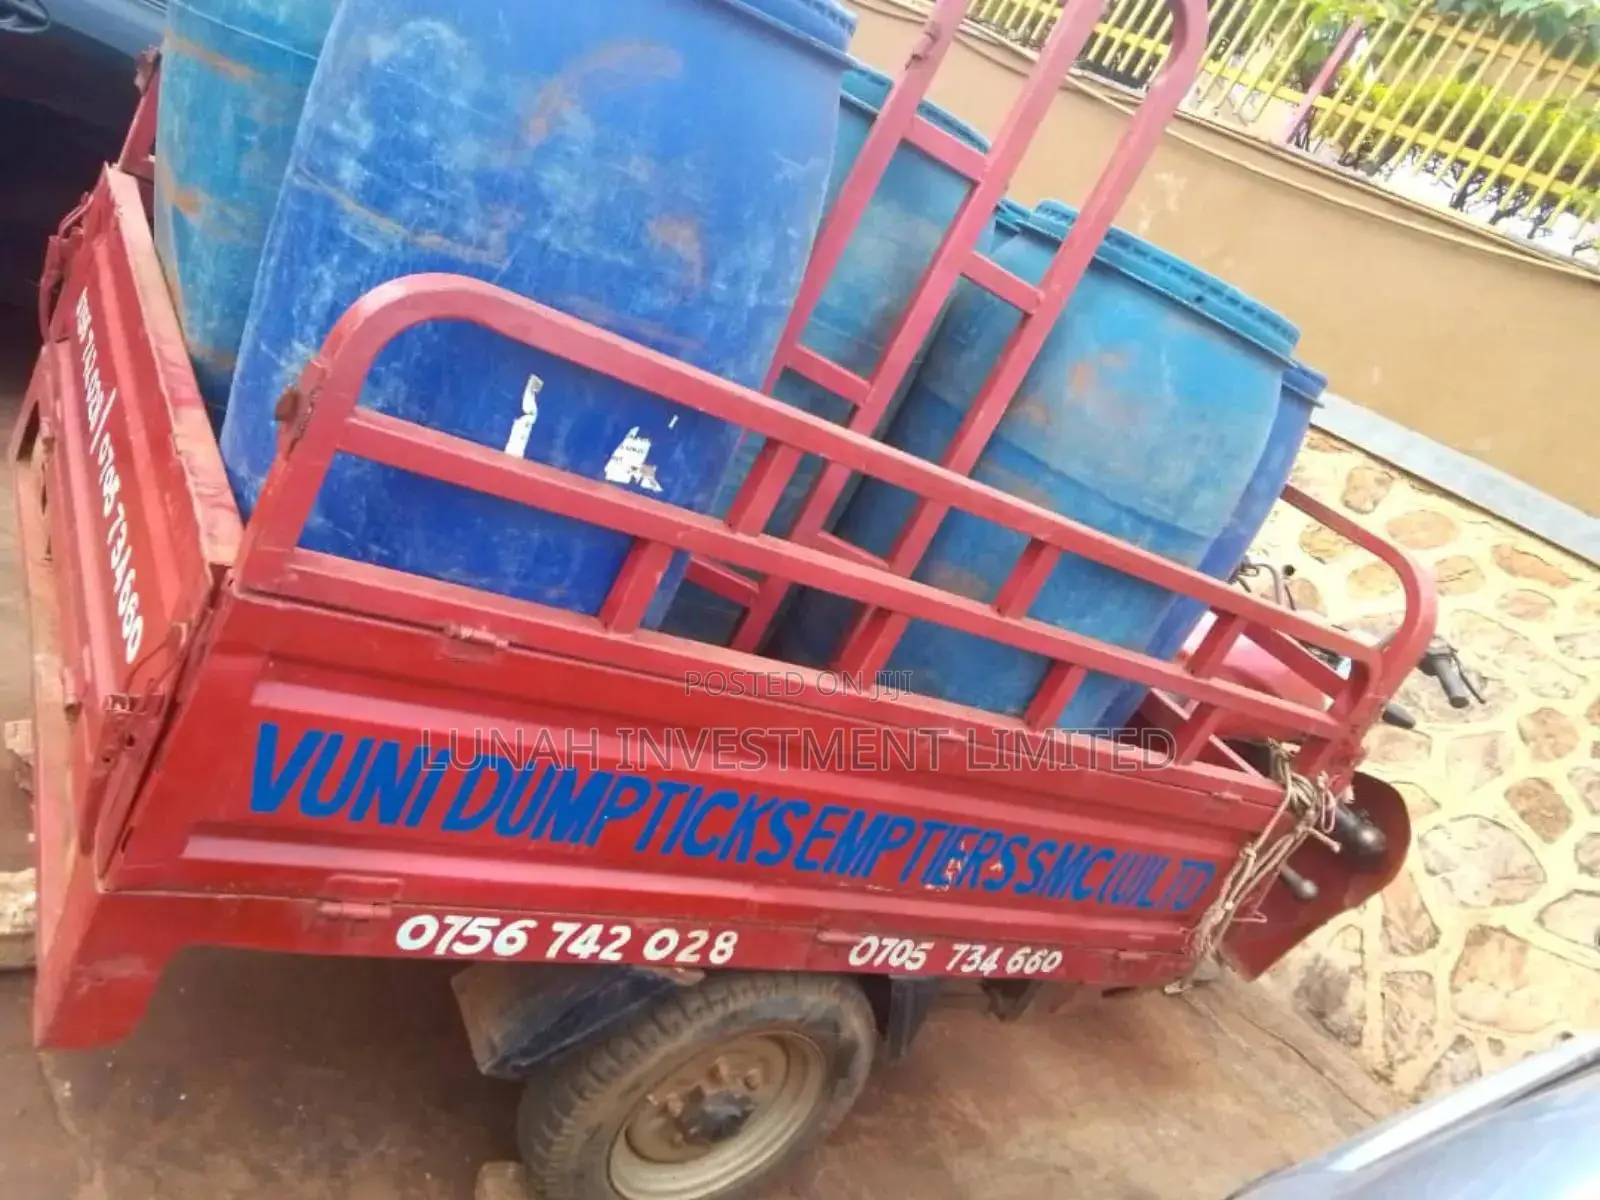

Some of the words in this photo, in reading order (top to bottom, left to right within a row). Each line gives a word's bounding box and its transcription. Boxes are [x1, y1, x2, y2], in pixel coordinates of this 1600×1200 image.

[249, 722, 451, 828] VUNI
[395, 914, 538, 957] 0756
[545, 921, 632, 962] 742
[643, 928, 738, 966] 028
[848, 935, 934, 971] 0705
[945, 943, 1004, 976] 734
[1005, 946, 1063, 974] 660
